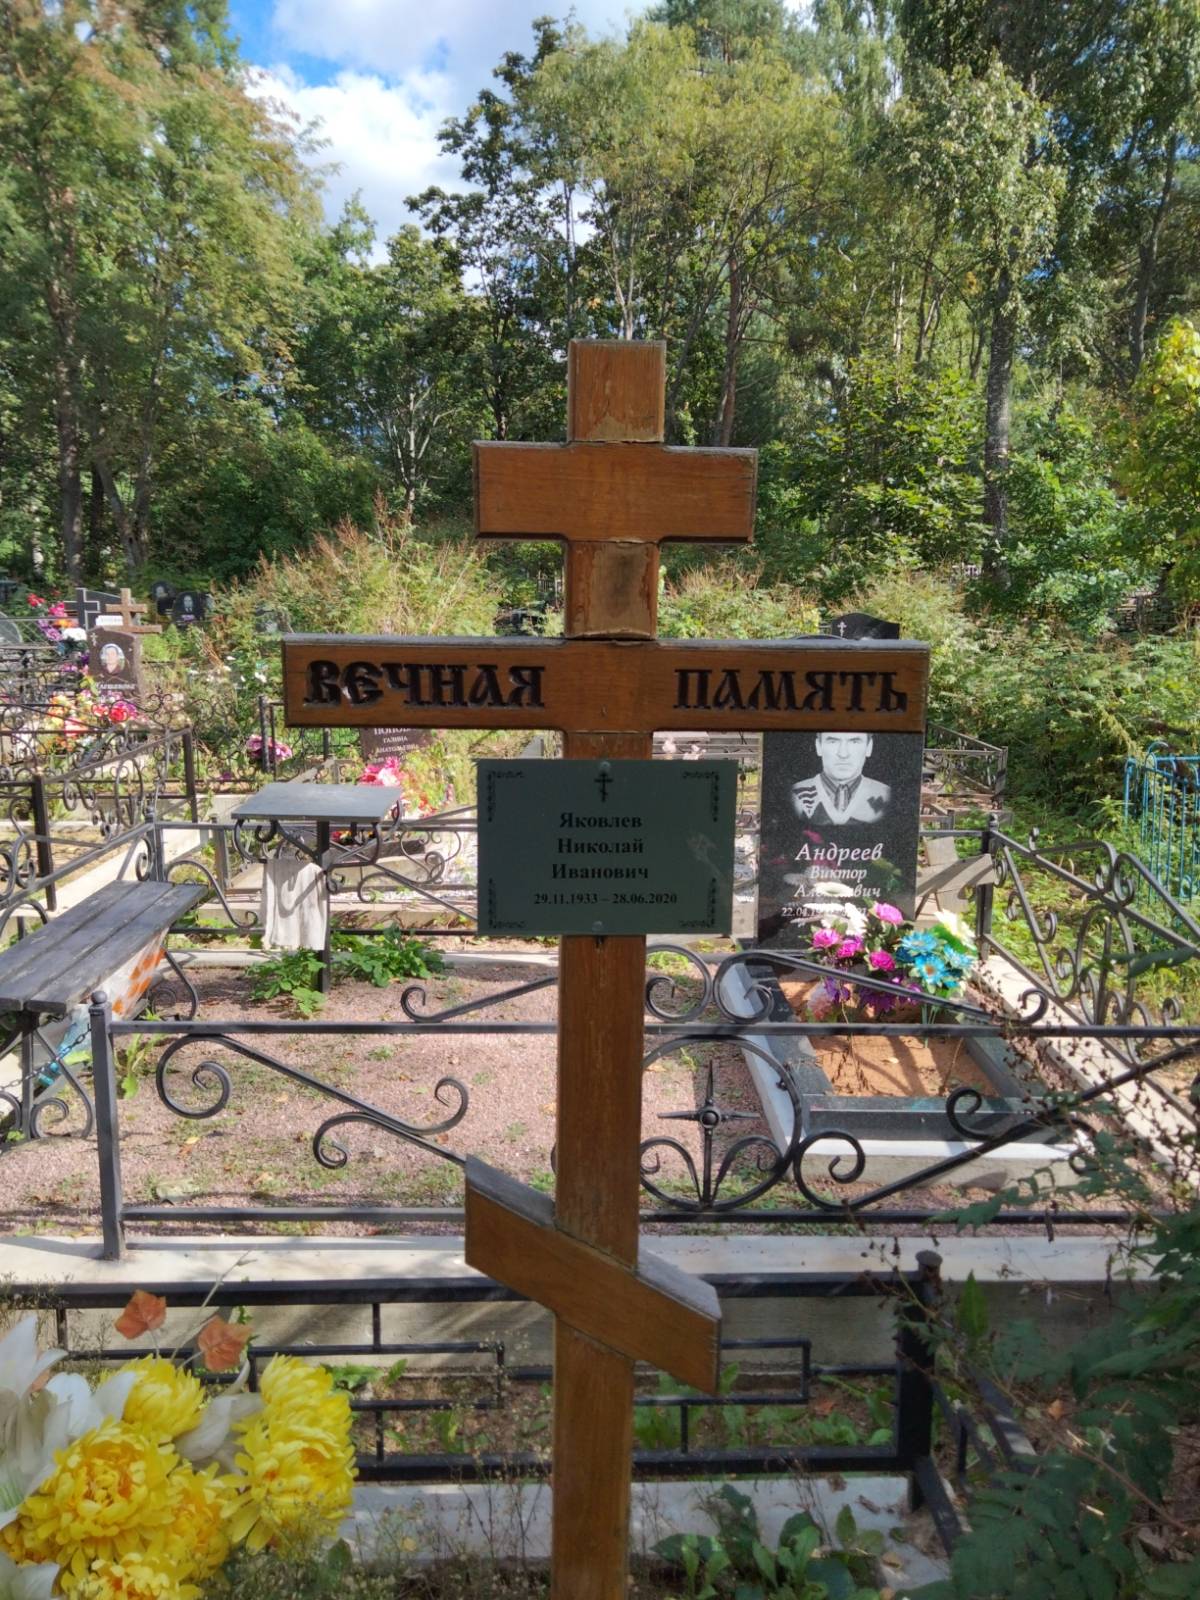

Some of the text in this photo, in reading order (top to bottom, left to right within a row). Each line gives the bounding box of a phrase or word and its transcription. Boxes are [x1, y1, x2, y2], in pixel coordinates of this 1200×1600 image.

[673, 668, 908, 712] ПАМЯТЬ
[559, 812, 642, 828] Яковлев
[557, 838, 644, 854] Николай
[794, 842, 884, 866] Андреев
[551, 864, 649, 880] Иванович
[810, 865, 867, 883] Виктор
[534, 893, 598, 904] 29.11.1933
[612, 893, 677, 904] 28.06.2020
